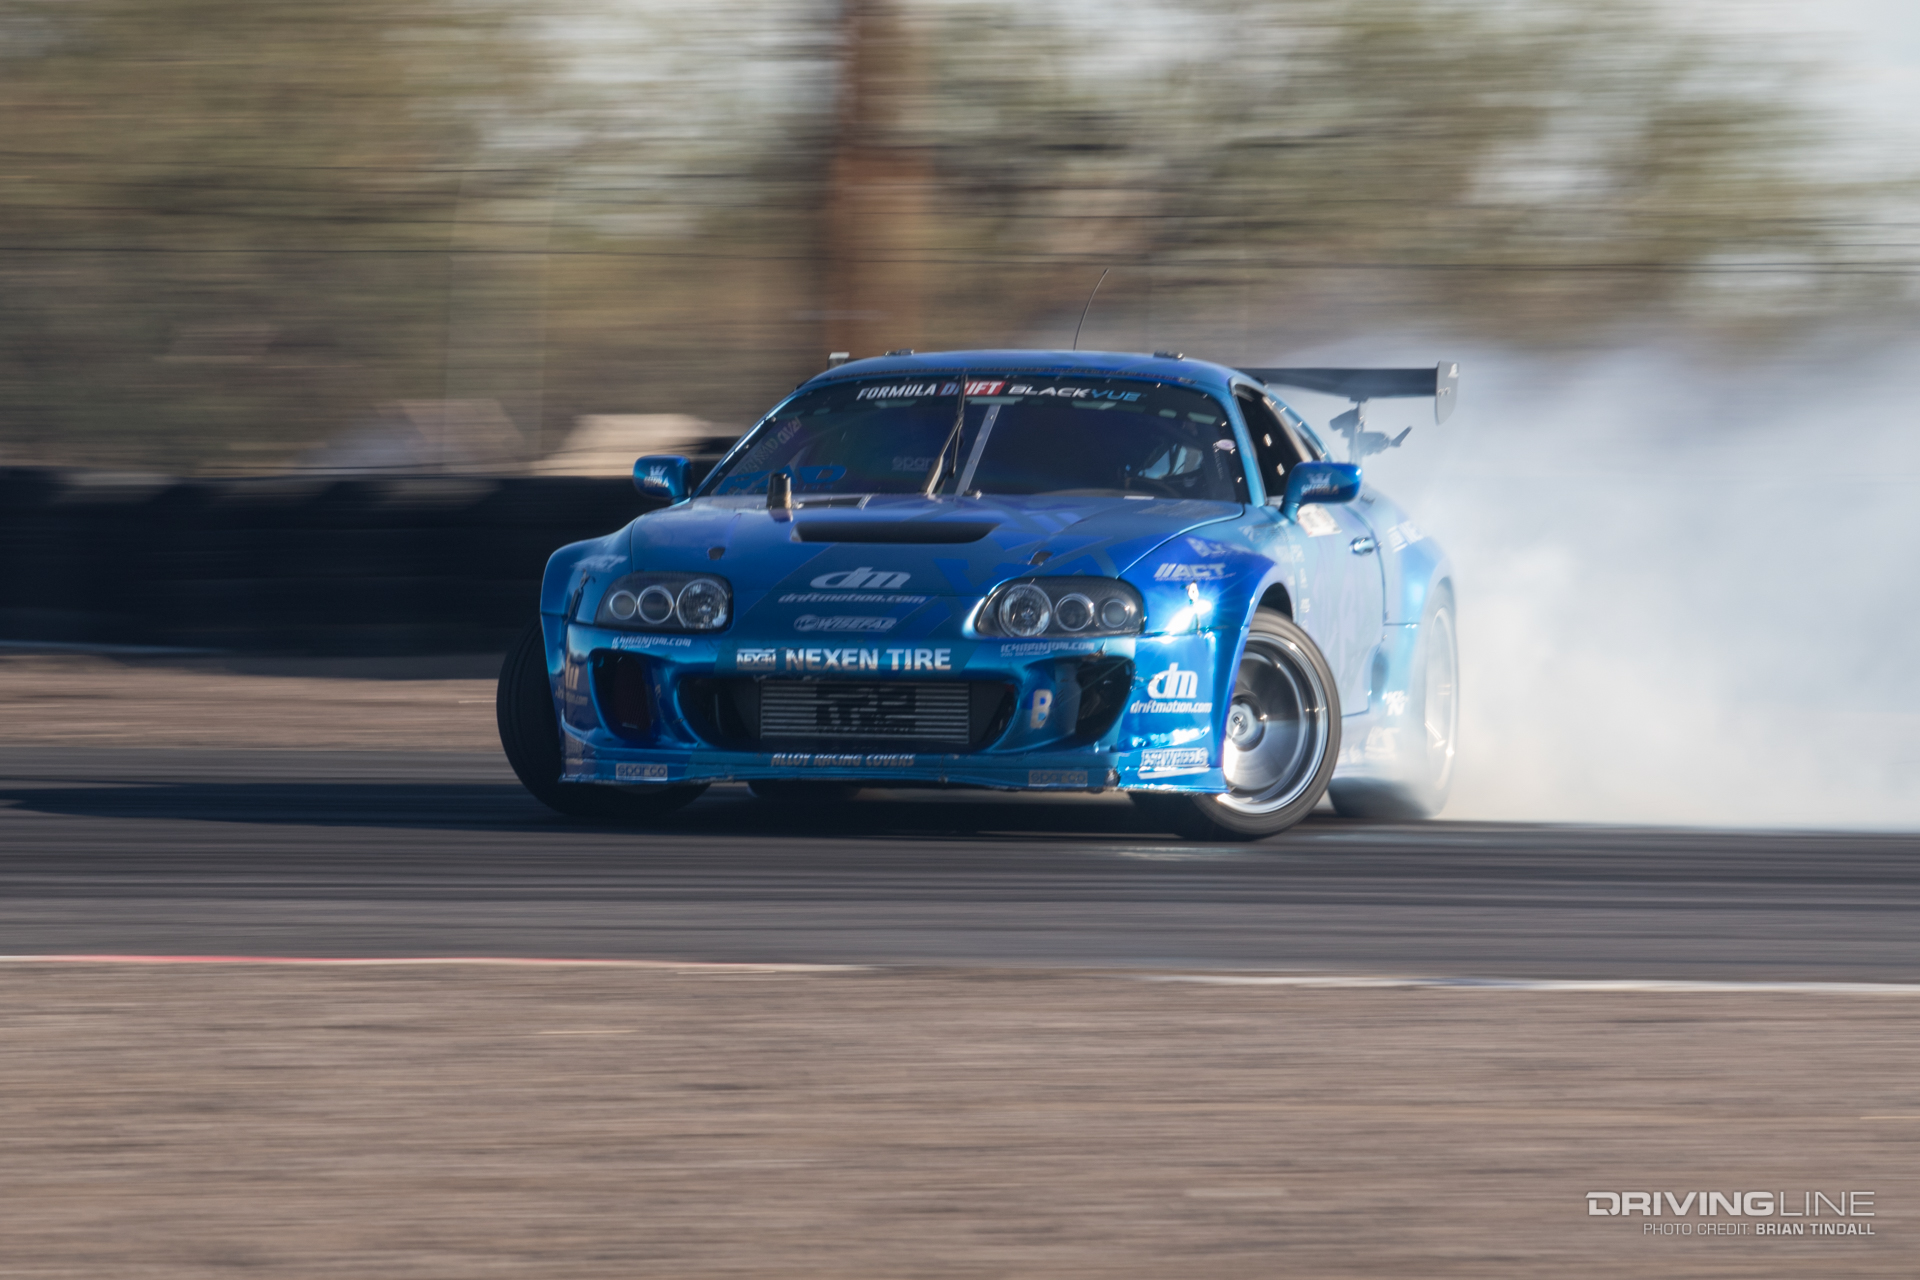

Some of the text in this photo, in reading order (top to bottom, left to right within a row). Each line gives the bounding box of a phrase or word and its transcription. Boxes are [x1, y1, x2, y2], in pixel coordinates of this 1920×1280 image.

[856, 383, 936, 400] FORMULA
[810, 566, 911, 589] dm
[778, 593, 926, 604] driftmotion.com
[785, 648, 952, 671] NEXEN TIRE
[1148, 663, 1198, 699] dm
[1130, 700, 1212, 714] driftmotion.com
[771, 753, 916, 767] ALLOY RACING COVERS
[617, 765, 667, 777] sparco
